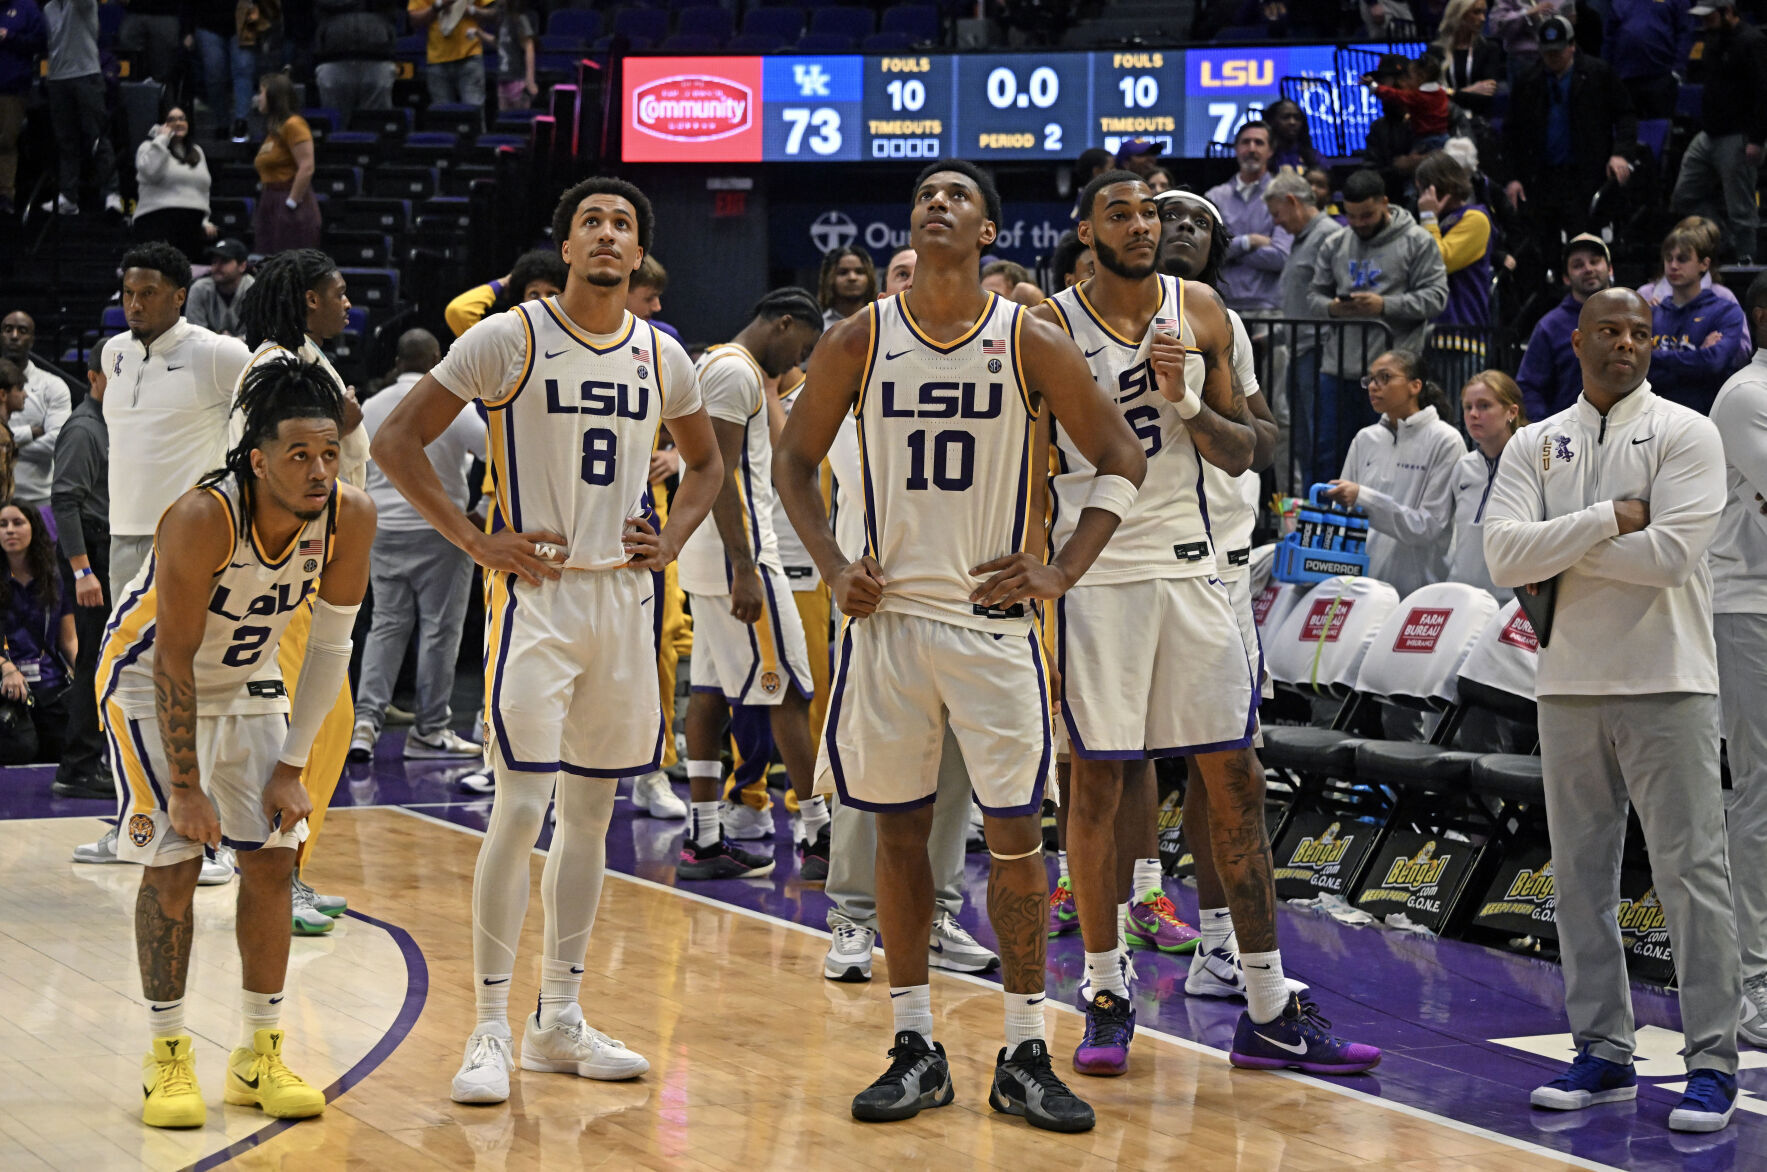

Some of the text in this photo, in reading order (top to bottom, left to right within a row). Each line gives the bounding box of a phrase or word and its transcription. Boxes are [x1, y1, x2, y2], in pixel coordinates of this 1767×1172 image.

[881, 57, 930, 73] FOULS
[1113, 53, 1163, 69] FOULS
[1201, 59, 1274, 87] LSU
[887, 79, 926, 111] 10
[987, 66, 1059, 109] 0.0
[1119, 75, 1159, 109] 10
[640, 94, 746, 124] Community
[782, 107, 842, 155] 73
[868, 119, 942, 135] TIMEOUTS
[979, 123, 1063, 151] PERIOD 2
[1100, 117, 1175, 132] TIMEOUTS
[996, 221, 1024, 248] of
[545, 379, 649, 421] LSU
[882, 381, 1003, 419] LSU
[581, 427, 617, 487] 8
[906, 429, 976, 492] 10
[1543, 435, 1552, 471] LSU
[1305, 560, 1361, 576] POWERADE
[208, 578, 314, 622] LSU
[1404, 624, 1440, 637] BUREAU
[1419, 613, 1445, 625] FARM
[222, 625, 272, 667] 2
[1290, 836, 1351, 868] Bengal
[1320, 865, 1340, 875] .com
[1385, 856, 1447, 888] Bengal
[1417, 886, 1438, 896] .com
[1507, 871, 1554, 900] Beng
[1542, 899, 1555, 909] .co
[1644, 932, 1668, 942] .com
